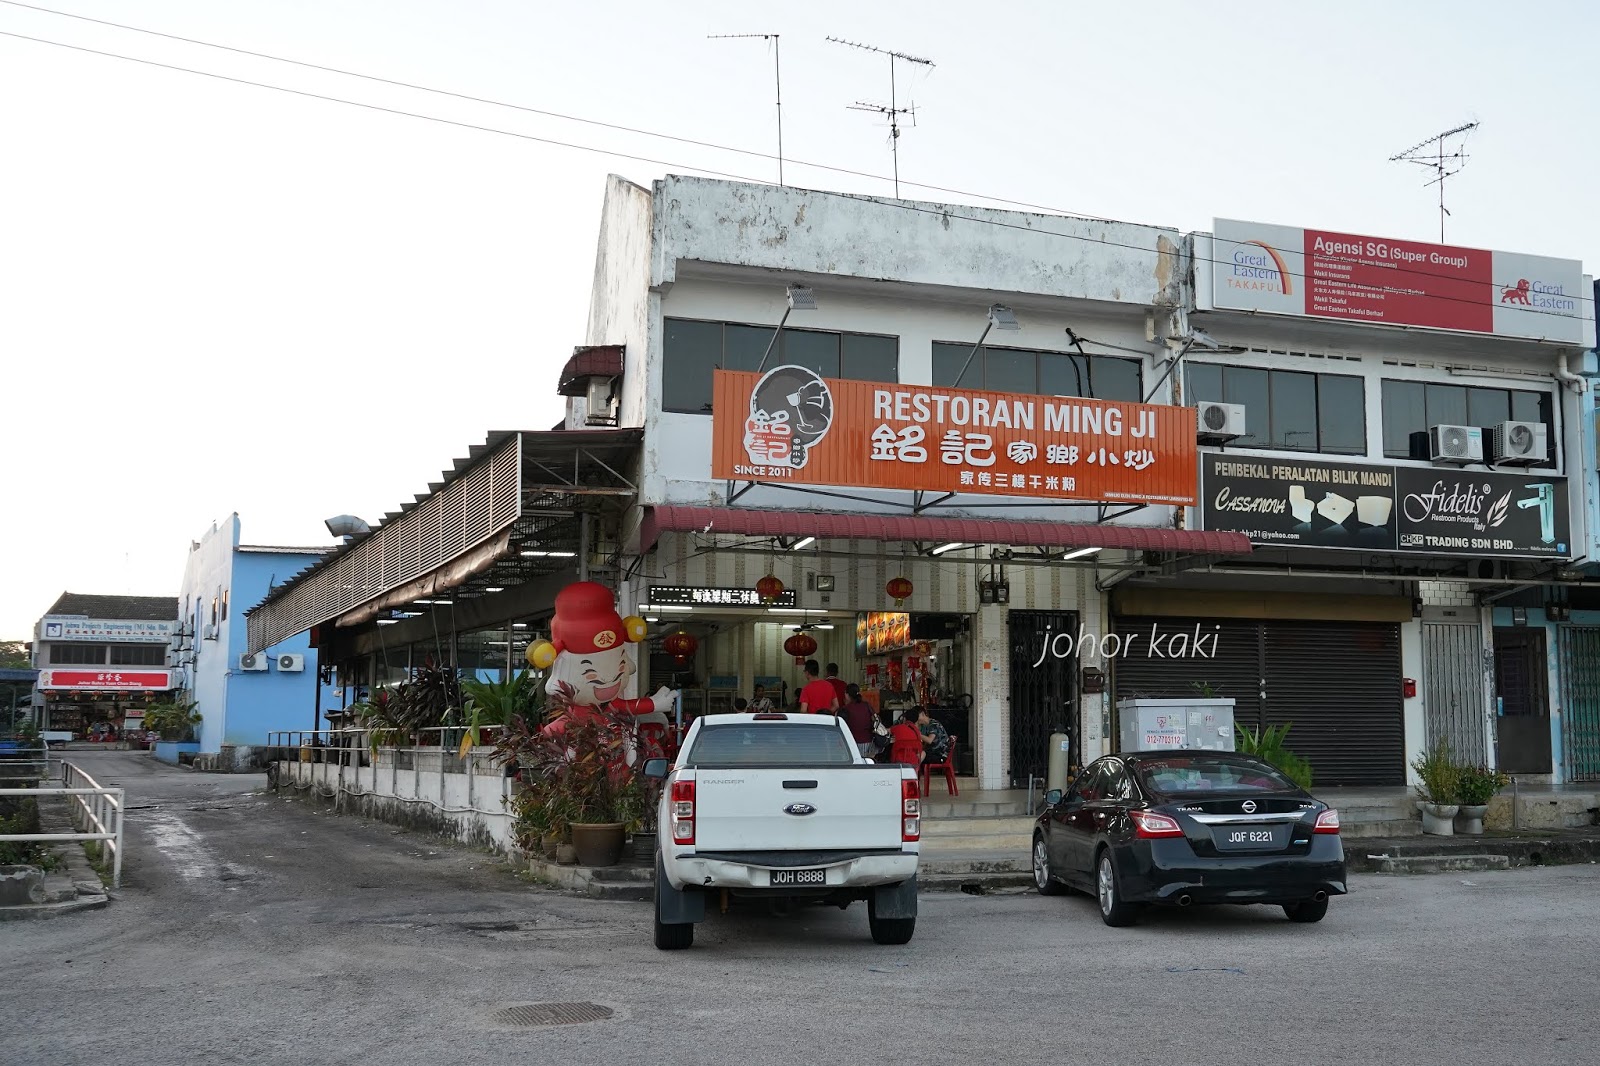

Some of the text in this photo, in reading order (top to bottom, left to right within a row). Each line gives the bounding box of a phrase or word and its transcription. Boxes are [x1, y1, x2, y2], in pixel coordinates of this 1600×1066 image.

[1234, 251, 1266, 266] Great
[1314, 236, 1468, 268] Agensi SG (Super Group)
[1234, 264, 1277, 280] Eastern
[1314, 270, 1350, 280] Wakil Insurans
[1228, 278, 1282, 292] TAKAFUL
[1314, 278, 1327, 286] Great
[1532, 280, 1564, 296] Great
[1314, 295, 1347, 304] Wakil Takaful
[1532, 294, 1574, 310] Eastern
[1314, 304, 1384, 317] Great Eastern Takaful Berhad
[874, 390, 1155, 438] RESTORAN MING JI
[734, 464, 792, 477] SINCE 2011
[1215, 462, 1392, 487] PEMBEKAL PERALATAN BILIK MANDI
[1431, 514, 1479, 524] Restroom Products
[1474, 522, 1486, 532] Italy
[1400, 534, 1423, 544] CHKP
[1426, 536, 1513, 550] TRADING SDN BHD
[791, 804, 810, 813] Ford
[1228, 832, 1273, 842] JQF 6221
[797, 870, 824, 882] 6888
